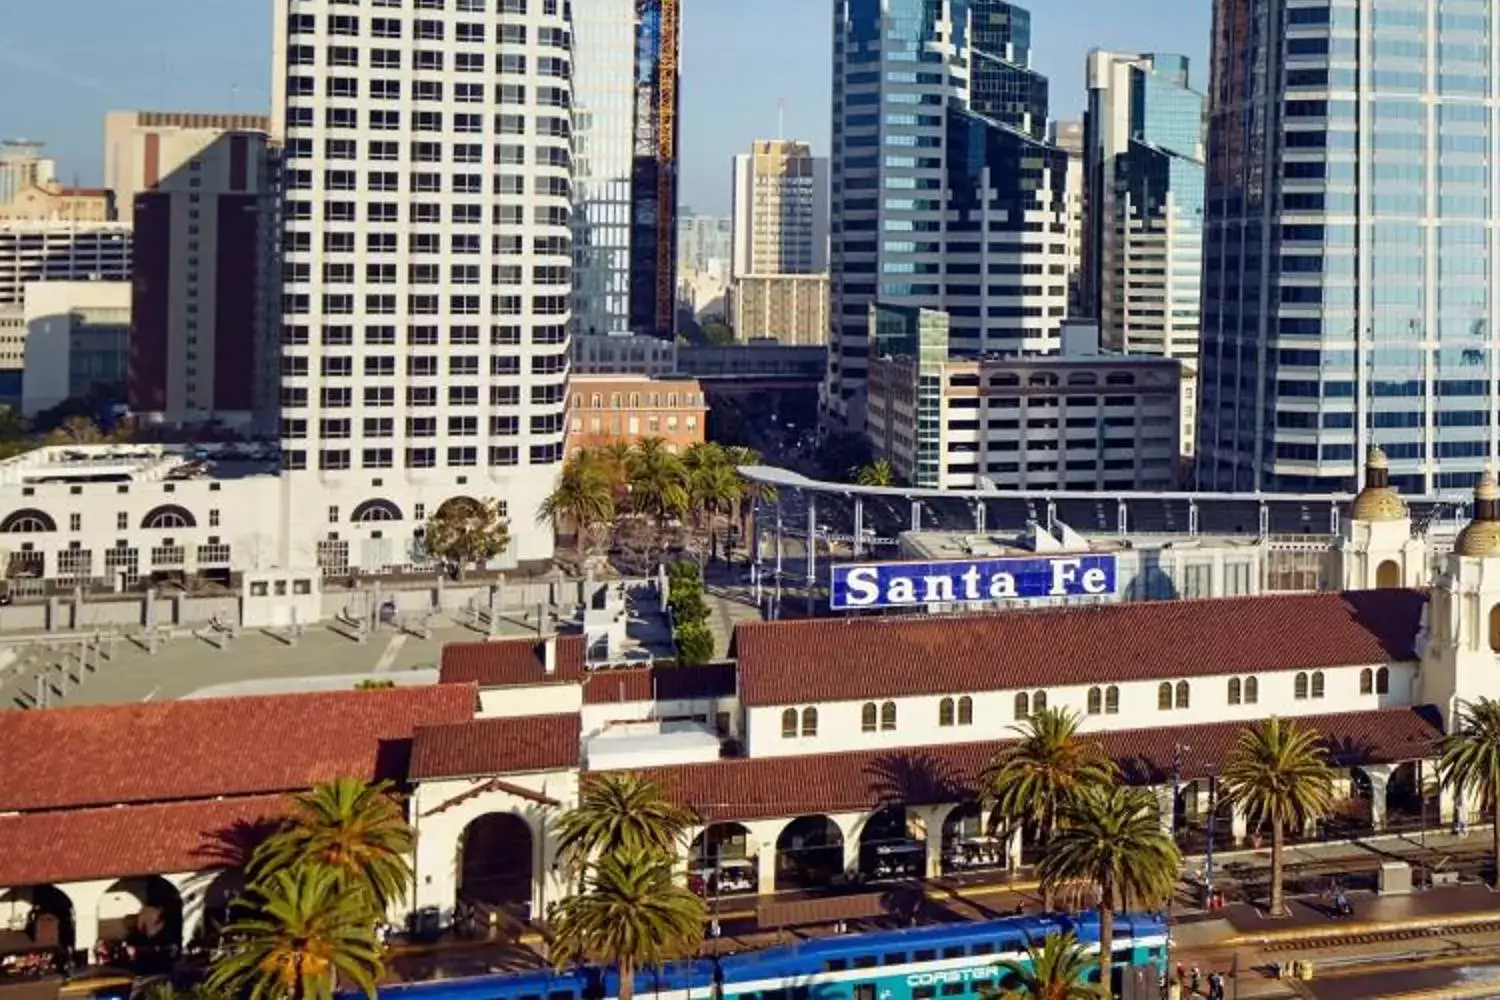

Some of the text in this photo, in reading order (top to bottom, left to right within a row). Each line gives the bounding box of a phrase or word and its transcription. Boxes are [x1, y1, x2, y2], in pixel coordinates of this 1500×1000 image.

[845, 559, 1107, 605] Santa Fe
[906, 967, 999, 987] COASTER
